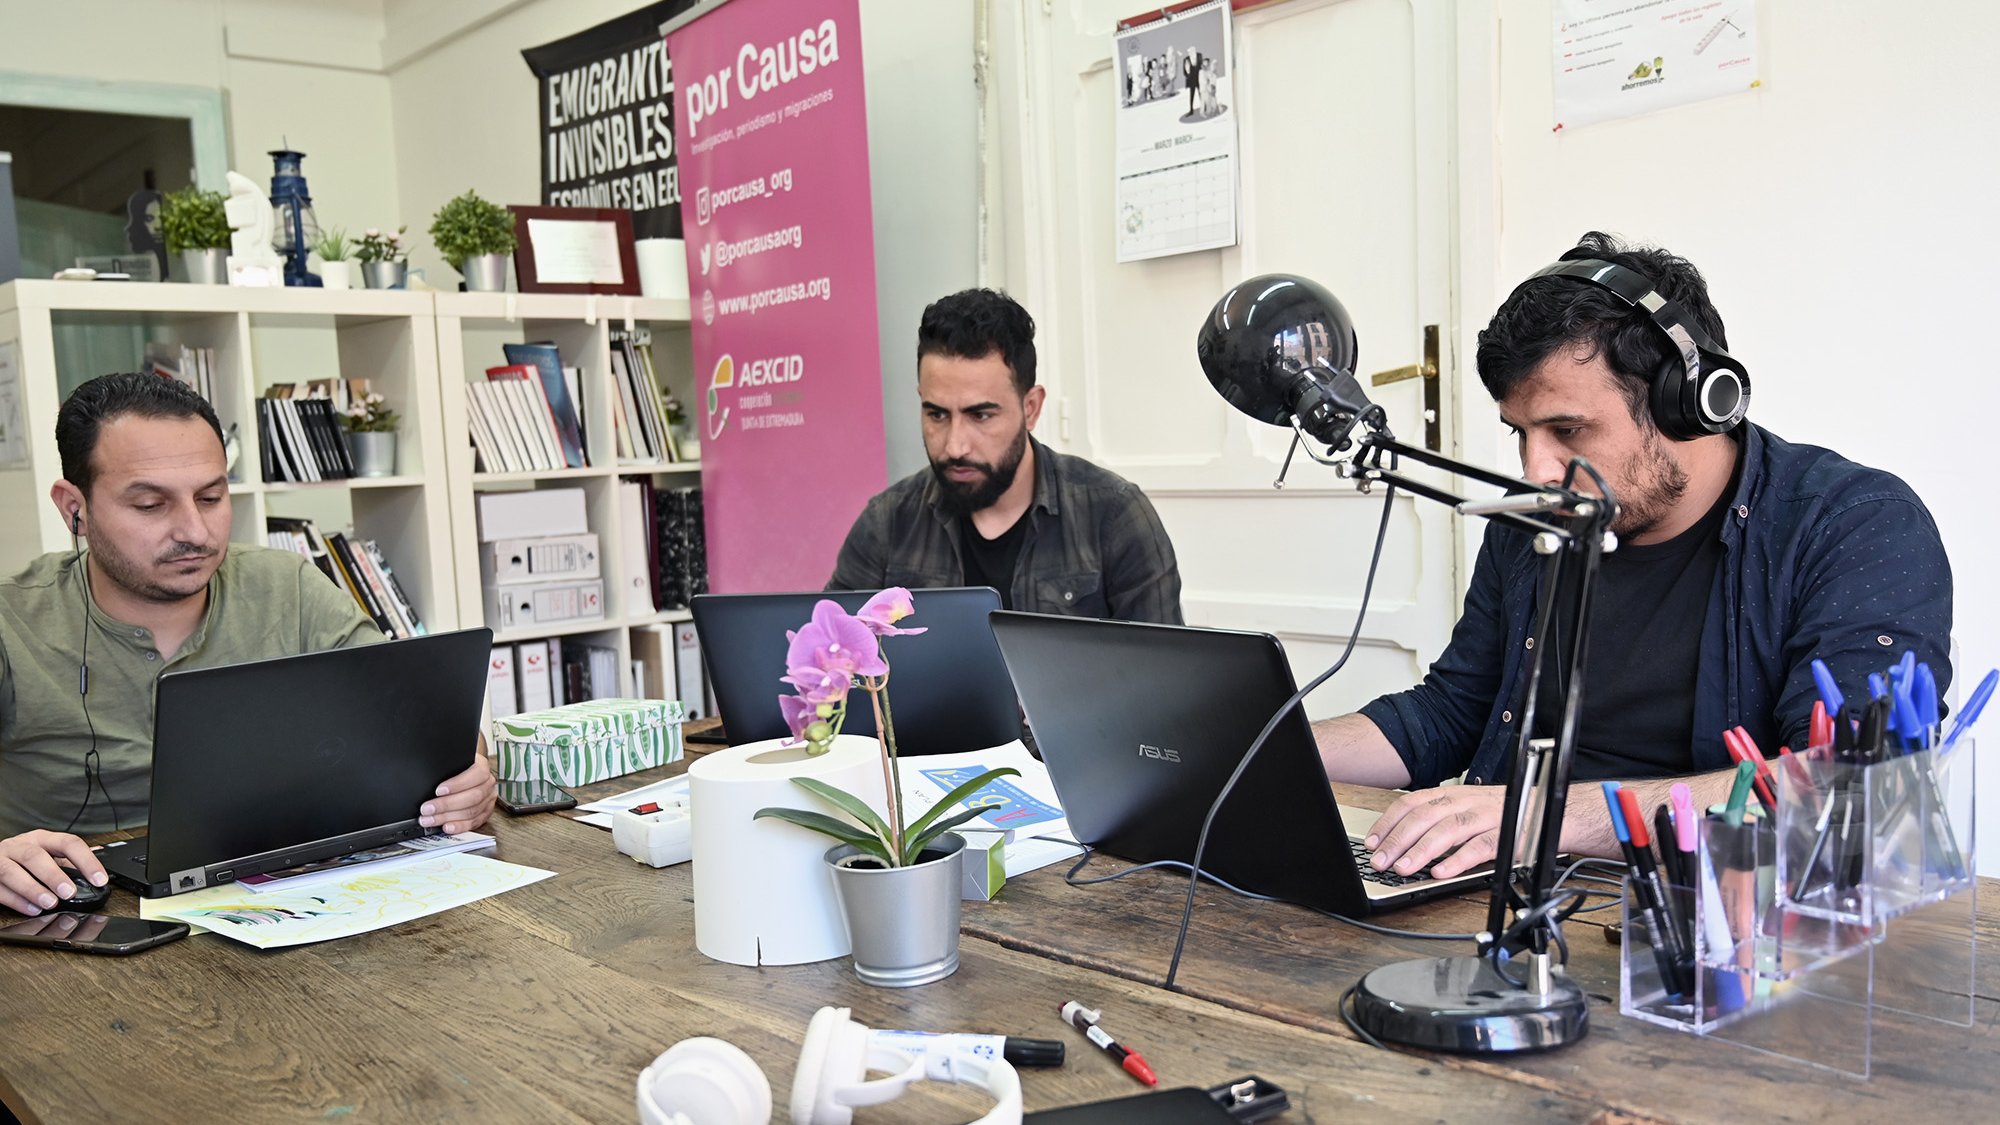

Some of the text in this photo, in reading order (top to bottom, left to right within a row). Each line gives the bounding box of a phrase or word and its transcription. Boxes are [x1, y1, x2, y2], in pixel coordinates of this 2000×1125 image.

[685, 18, 840, 138] por Causa
[736, 111, 776, 139] periodismo
[784, 88, 833, 118] migraciones
[549, 102, 673, 184] INVISIBLES
[633, 171, 656, 211] EN
[711, 168, 793, 213] porcausa_org
[715, 225, 802, 267] @porcausaorg
[719, 277, 830, 314] www.porcausa.org
[738, 354, 804, 388] AEXCID
[1138, 744, 1181, 763] ASUS
